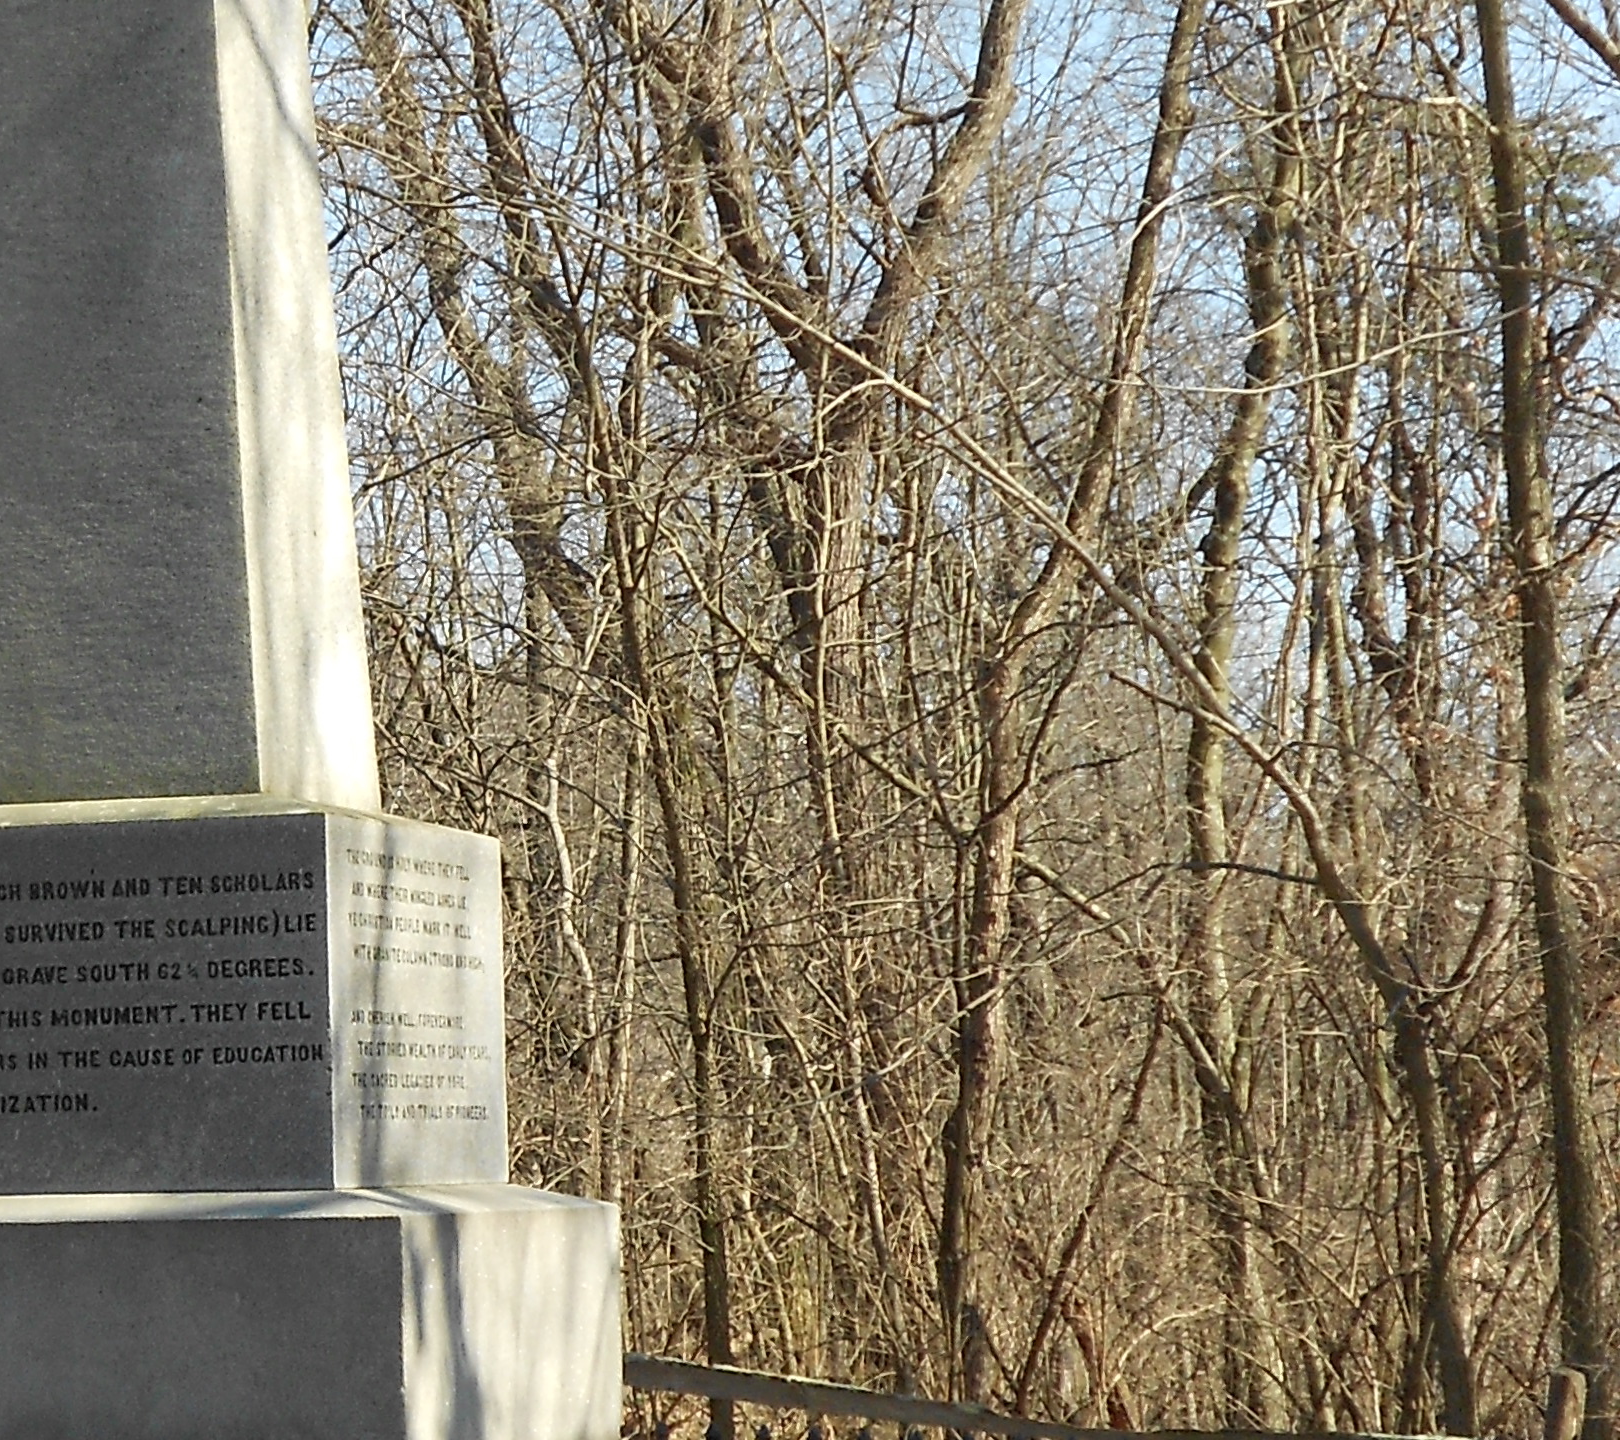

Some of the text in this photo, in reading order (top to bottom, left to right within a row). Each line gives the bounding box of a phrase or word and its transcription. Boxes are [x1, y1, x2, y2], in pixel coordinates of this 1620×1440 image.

[30, 879, 105, 901] BROWN
[112, 878, 150, 897] AND
[159, 875, 204, 896] TEN
[211, 871, 314, 894] SCHOLARS
[4, 920, 104, 944] SURVIVED
[114, 918, 155, 939] THE
[165, 910, 279, 938] SCALPING)
[284, 913, 317, 933] LIE
[2, 965, 68, 985] GRAVE
[77, 962, 149, 983] SOUTH
[208, 958, 314, 979] DEGREES.
[51, 1004, 185, 1027] MONUMENT.
[190, 1003, 248, 1024] THEY
[257, 1001, 311, 1021] FELL
[28, 1052, 48, 1070] IN
[58, 1050, 101, 1068] THE
[109, 1048, 175, 1068] CAUSE
[182, 1047, 204, 1065] OF
[212, 1044, 324, 1065] EDUCATION
